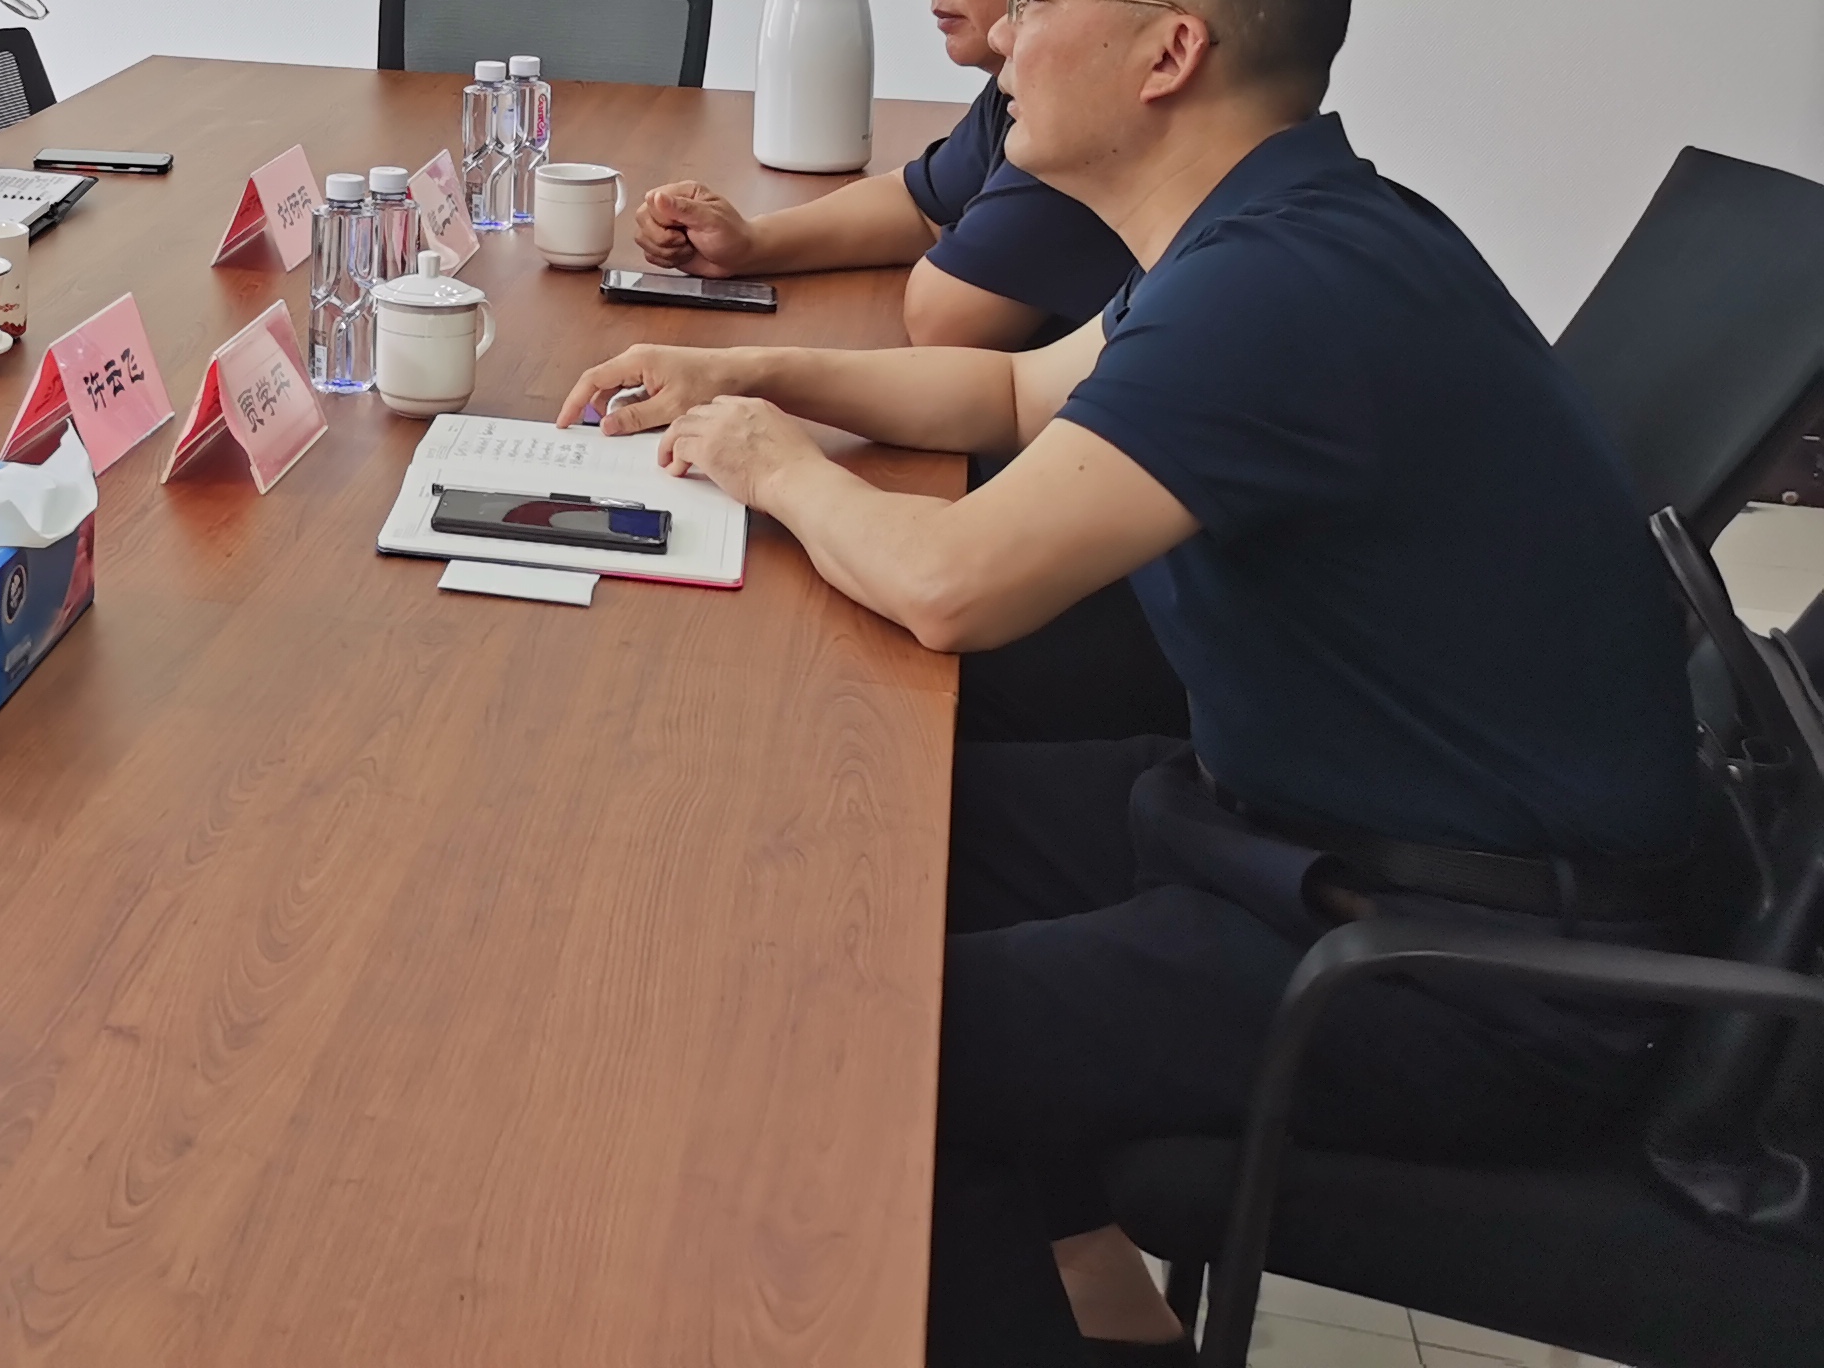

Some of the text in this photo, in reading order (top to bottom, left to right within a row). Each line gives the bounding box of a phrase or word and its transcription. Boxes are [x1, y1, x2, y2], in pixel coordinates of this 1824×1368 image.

[82, 347, 145, 412] 许云飞
[237, 361, 291, 433] 贾学平
